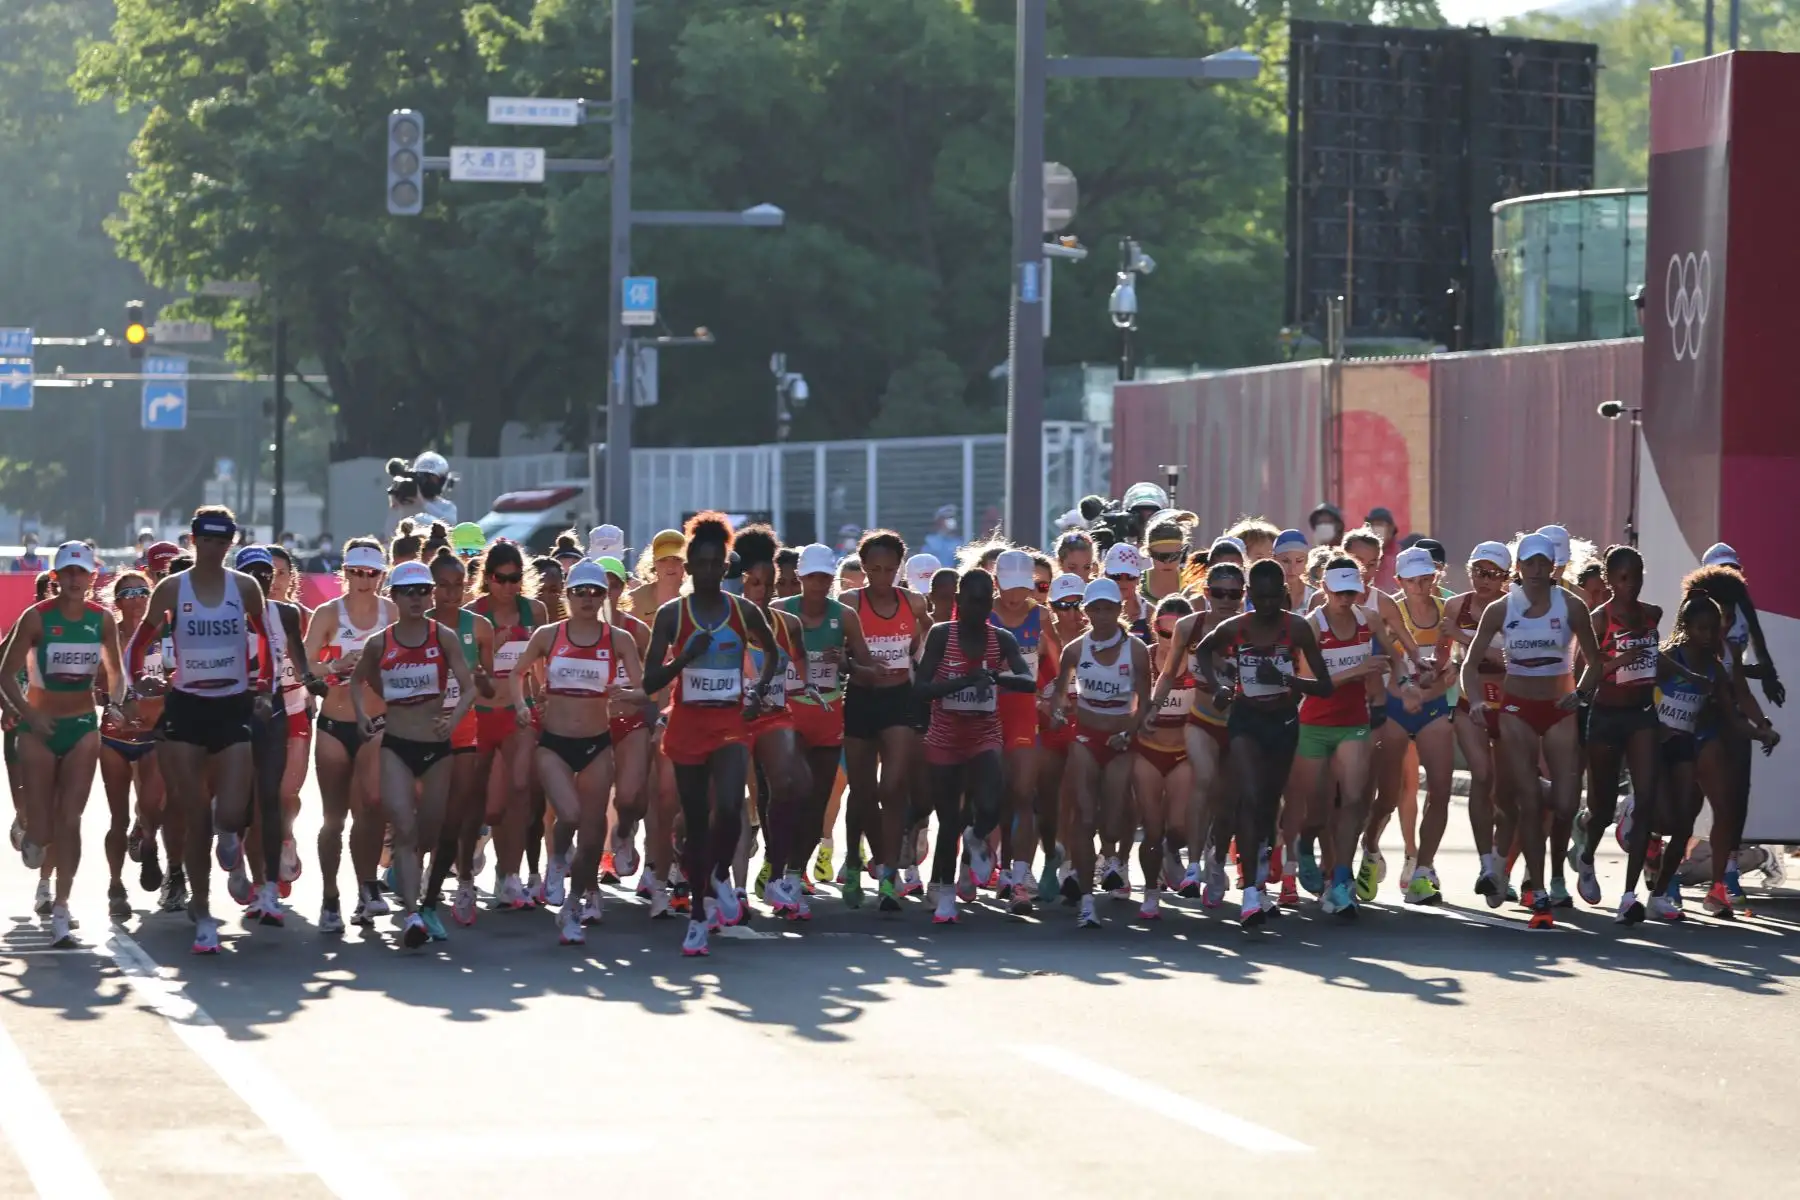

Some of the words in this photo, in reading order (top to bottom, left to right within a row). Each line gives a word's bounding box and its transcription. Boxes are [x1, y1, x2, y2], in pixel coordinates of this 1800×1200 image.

[187, 618, 240, 636] SUISSE
[1509, 639, 1557, 649] LISOWSKA
[53, 651, 98, 665] RIBEIRO
[186, 656, 235, 669] SCHLUMPF
[557, 667, 600, 680] ICHIYAMA
[390, 673, 431, 689] SUZUKI
[690, 674, 735, 692] WELDU
[1084, 679, 1120, 694] MACH
